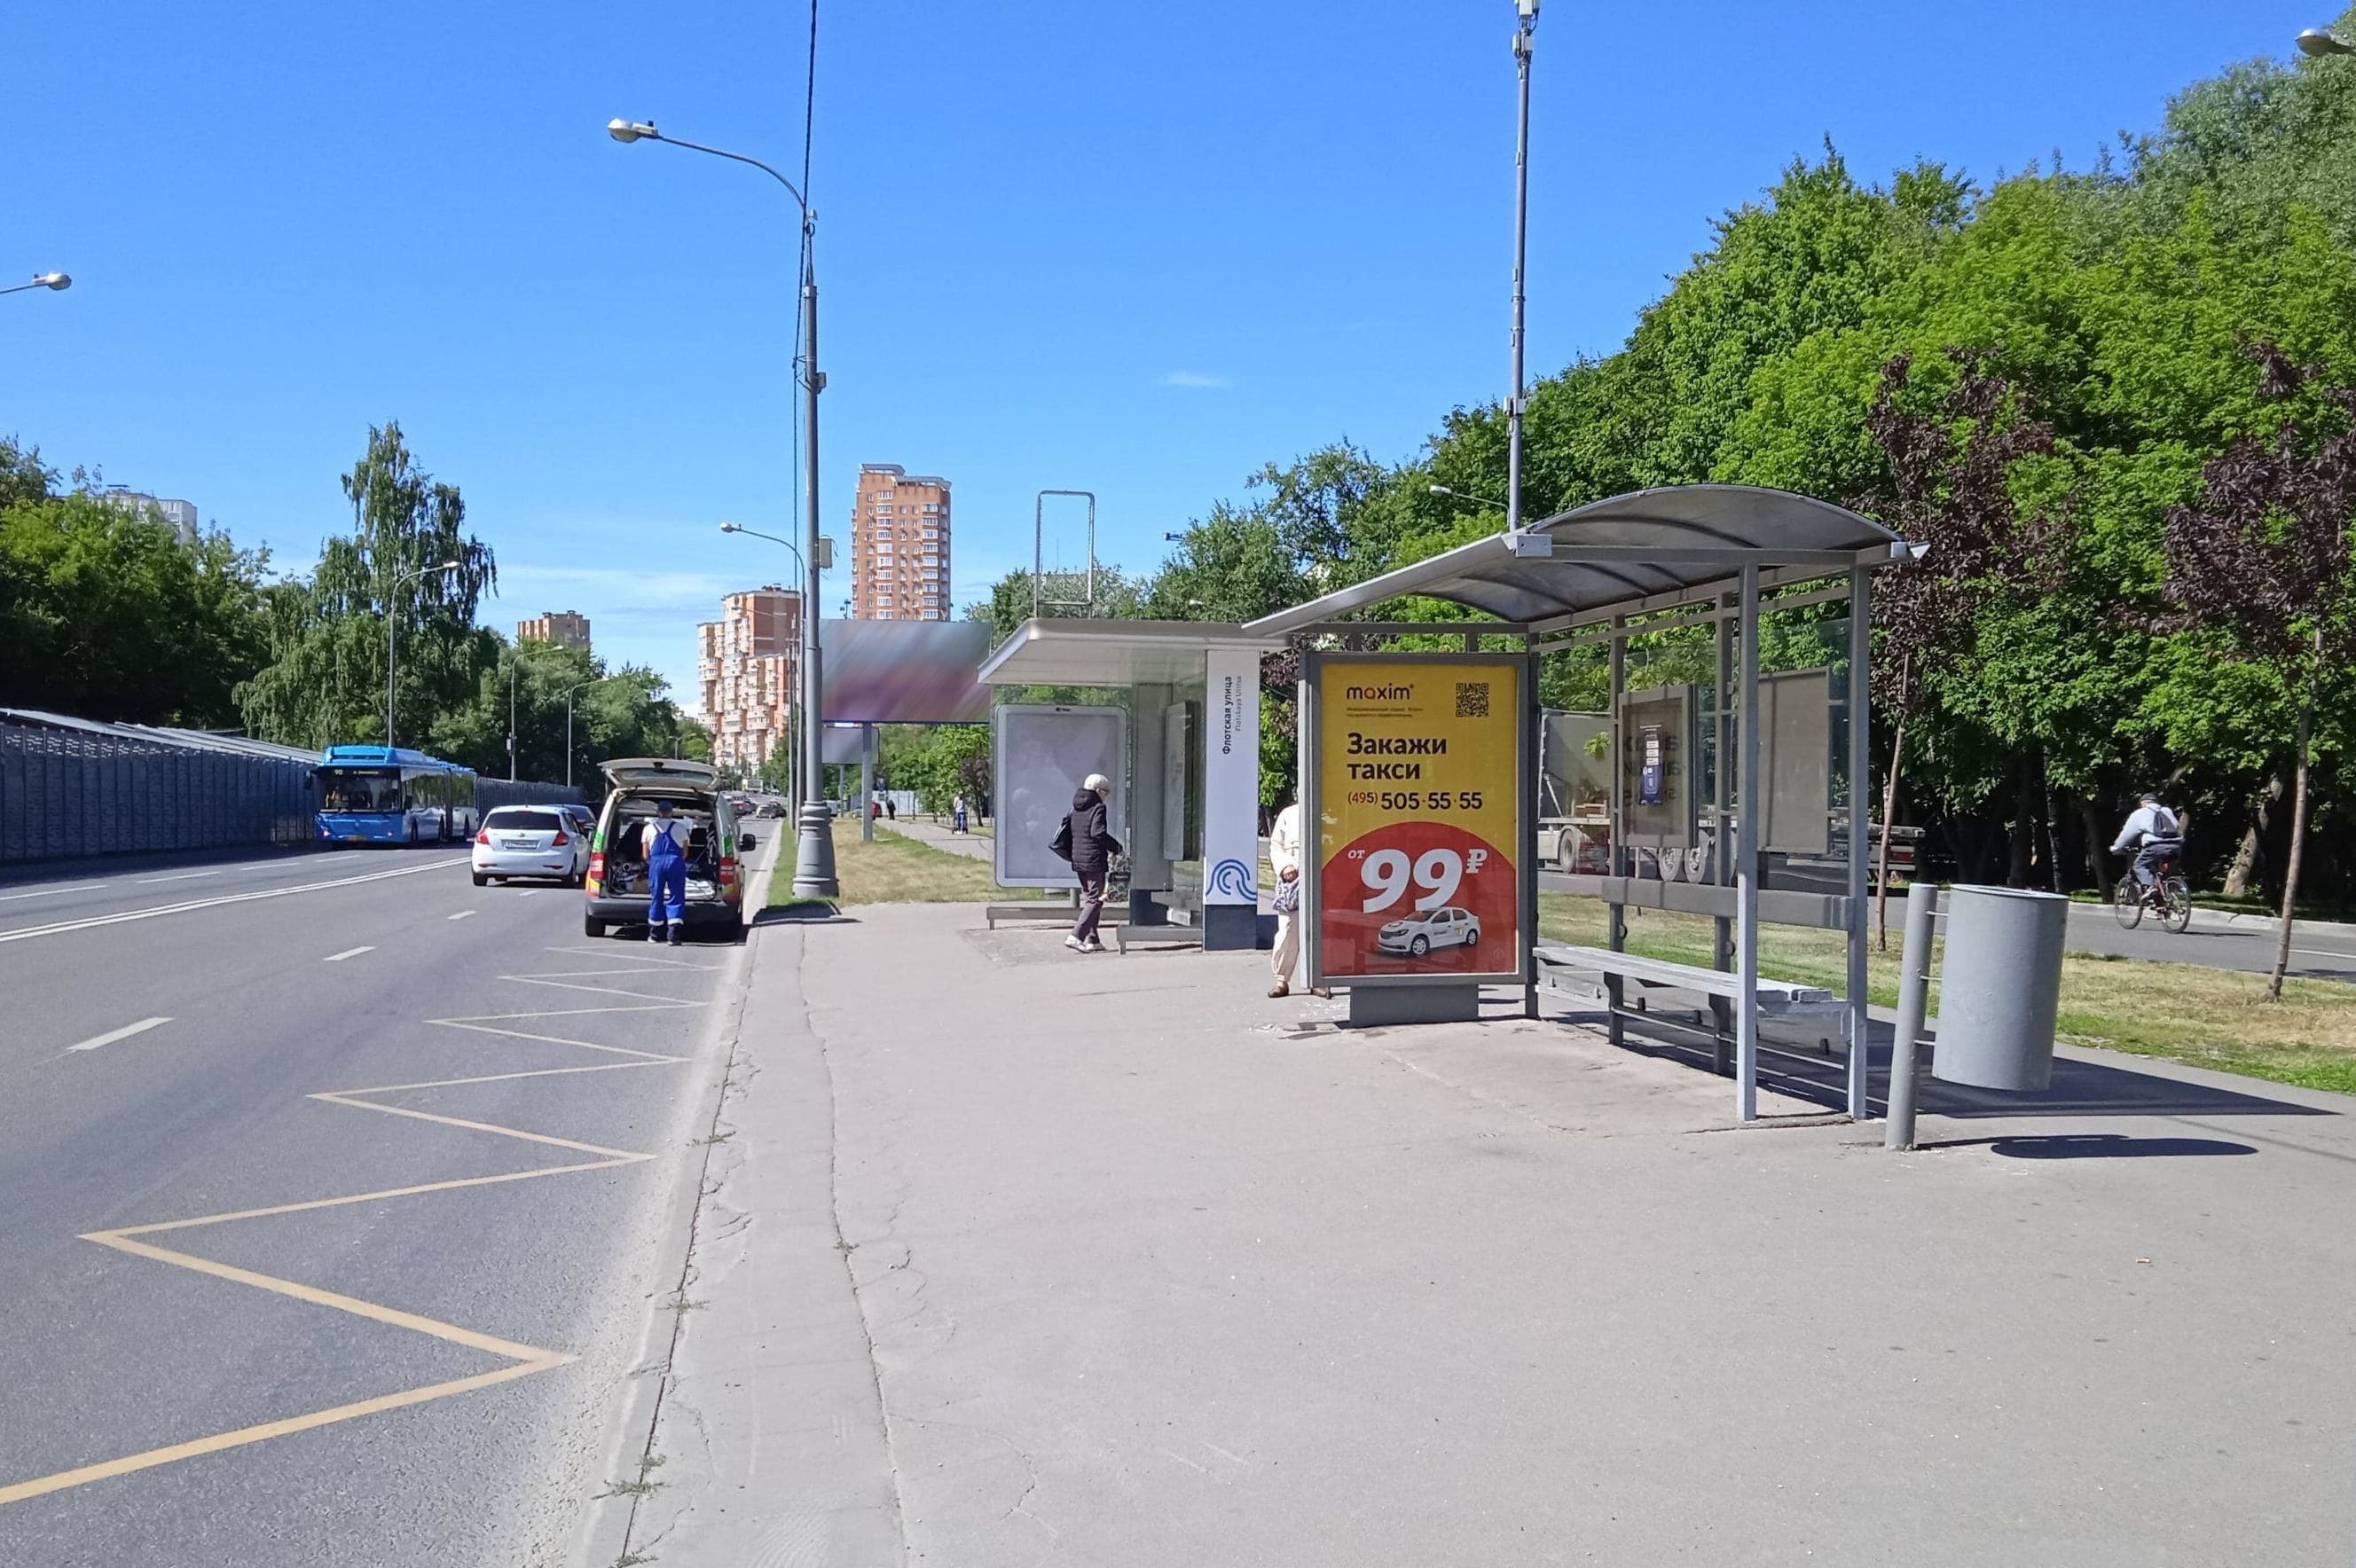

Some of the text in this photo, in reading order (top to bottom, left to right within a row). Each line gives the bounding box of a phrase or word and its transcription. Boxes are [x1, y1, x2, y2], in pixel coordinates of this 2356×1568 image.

[1347, 683, 1410, 701] maxim
[1222, 676, 1234, 755] Флотская улица
[1347, 732, 1448, 755] Закажи
[1347, 762, 1421, 780] такси
[1347, 791, 1378, 804] (495)
[1347, 850, 1366, 859] от
